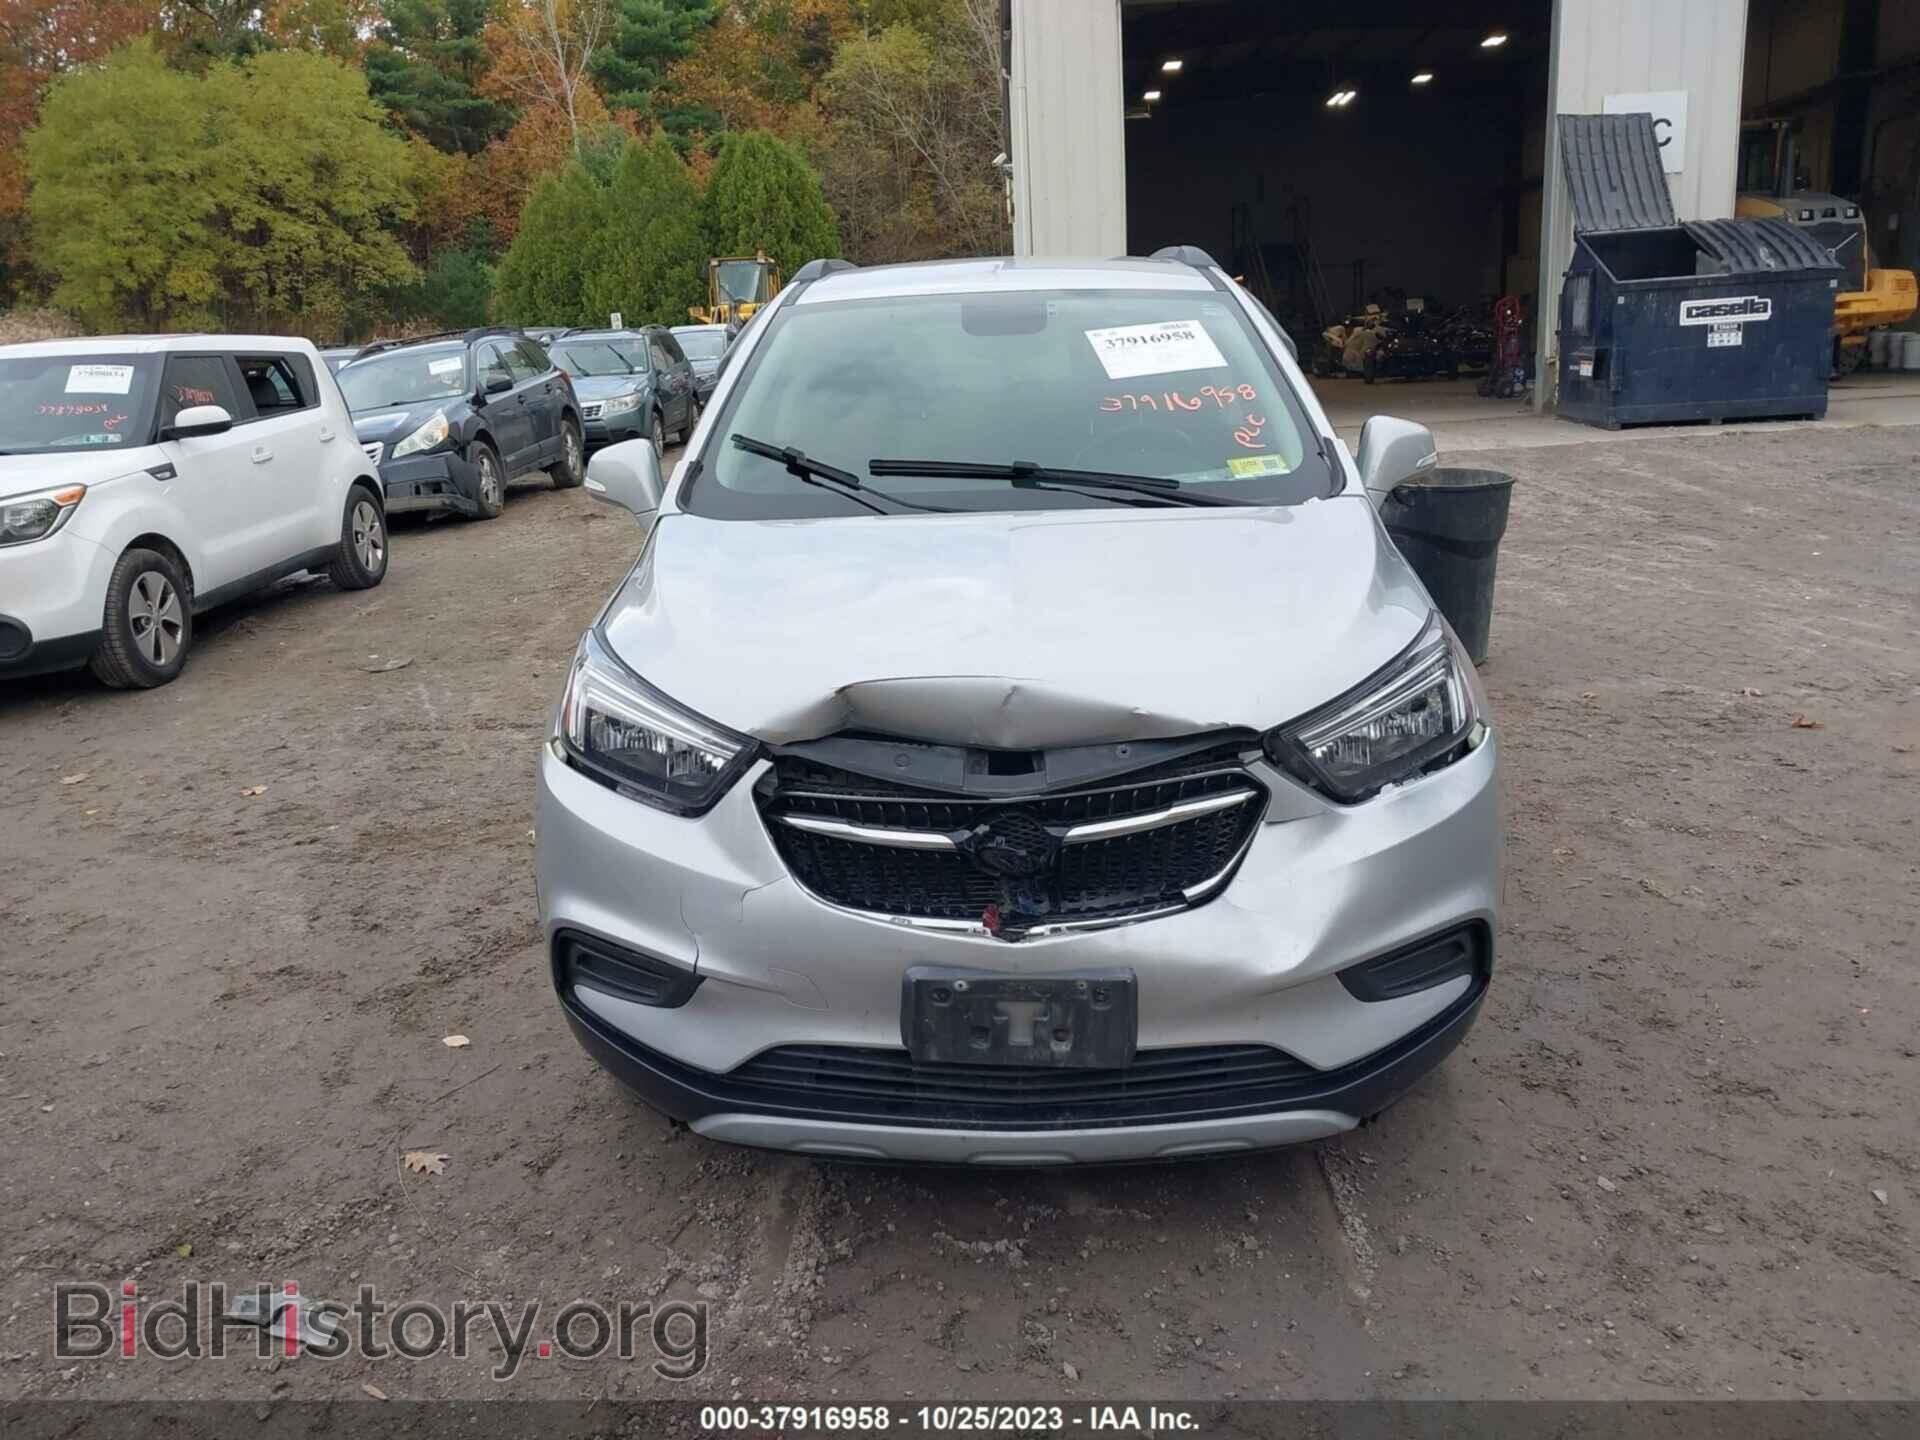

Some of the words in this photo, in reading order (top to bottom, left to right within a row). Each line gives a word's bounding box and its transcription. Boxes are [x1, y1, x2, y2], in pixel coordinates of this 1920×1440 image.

[1686, 299, 1769, 319] casella
[1104, 330, 1195, 351] 37916958
[1099, 384, 1257, 411] 37916958
